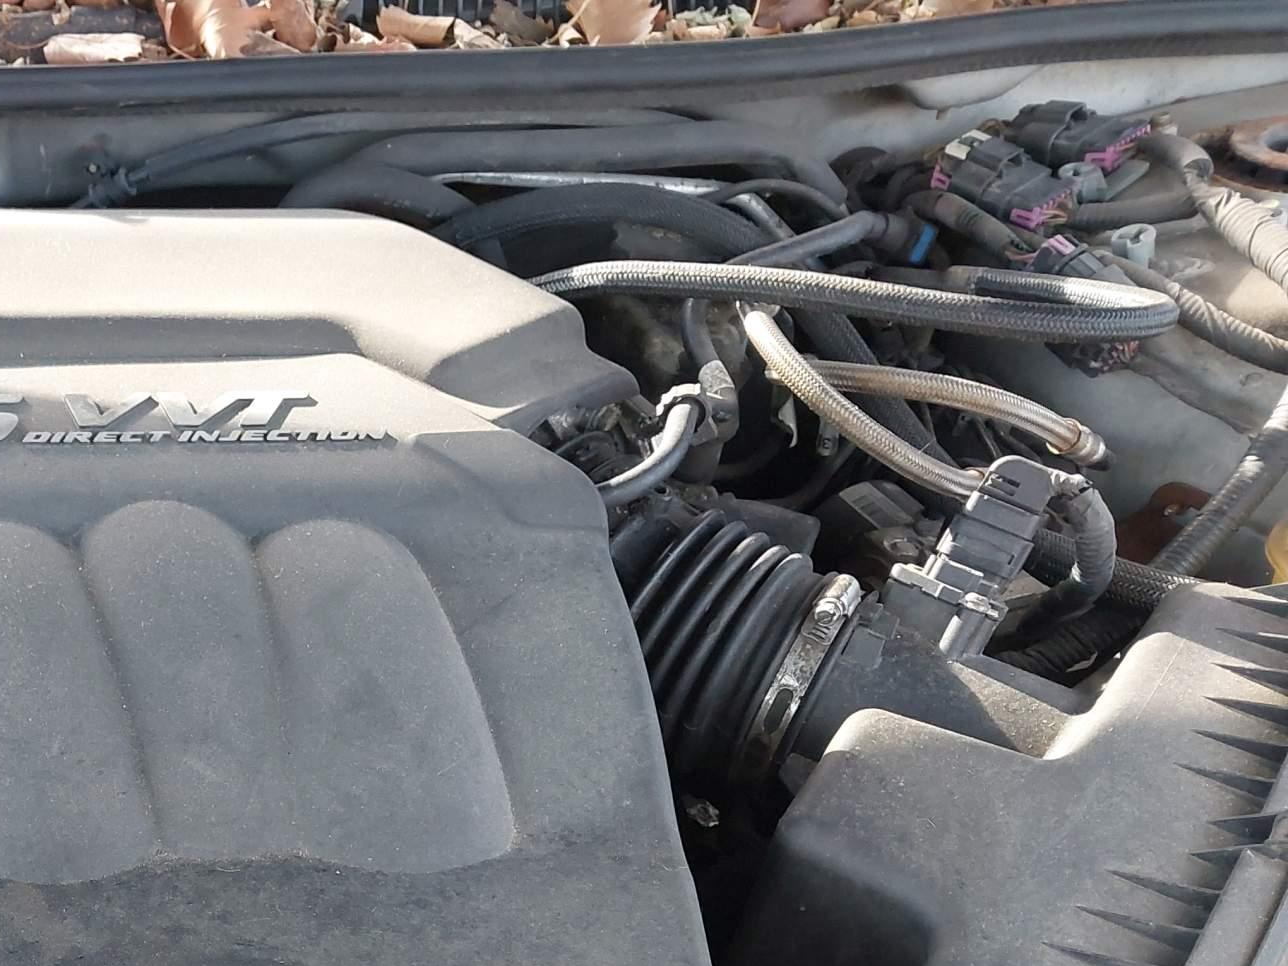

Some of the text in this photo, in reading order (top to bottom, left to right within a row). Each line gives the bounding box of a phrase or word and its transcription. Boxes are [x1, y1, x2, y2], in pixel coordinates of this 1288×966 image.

[63, 391, 314, 430] VVT
[22, 429, 392, 443] DIRECT INJECTION
